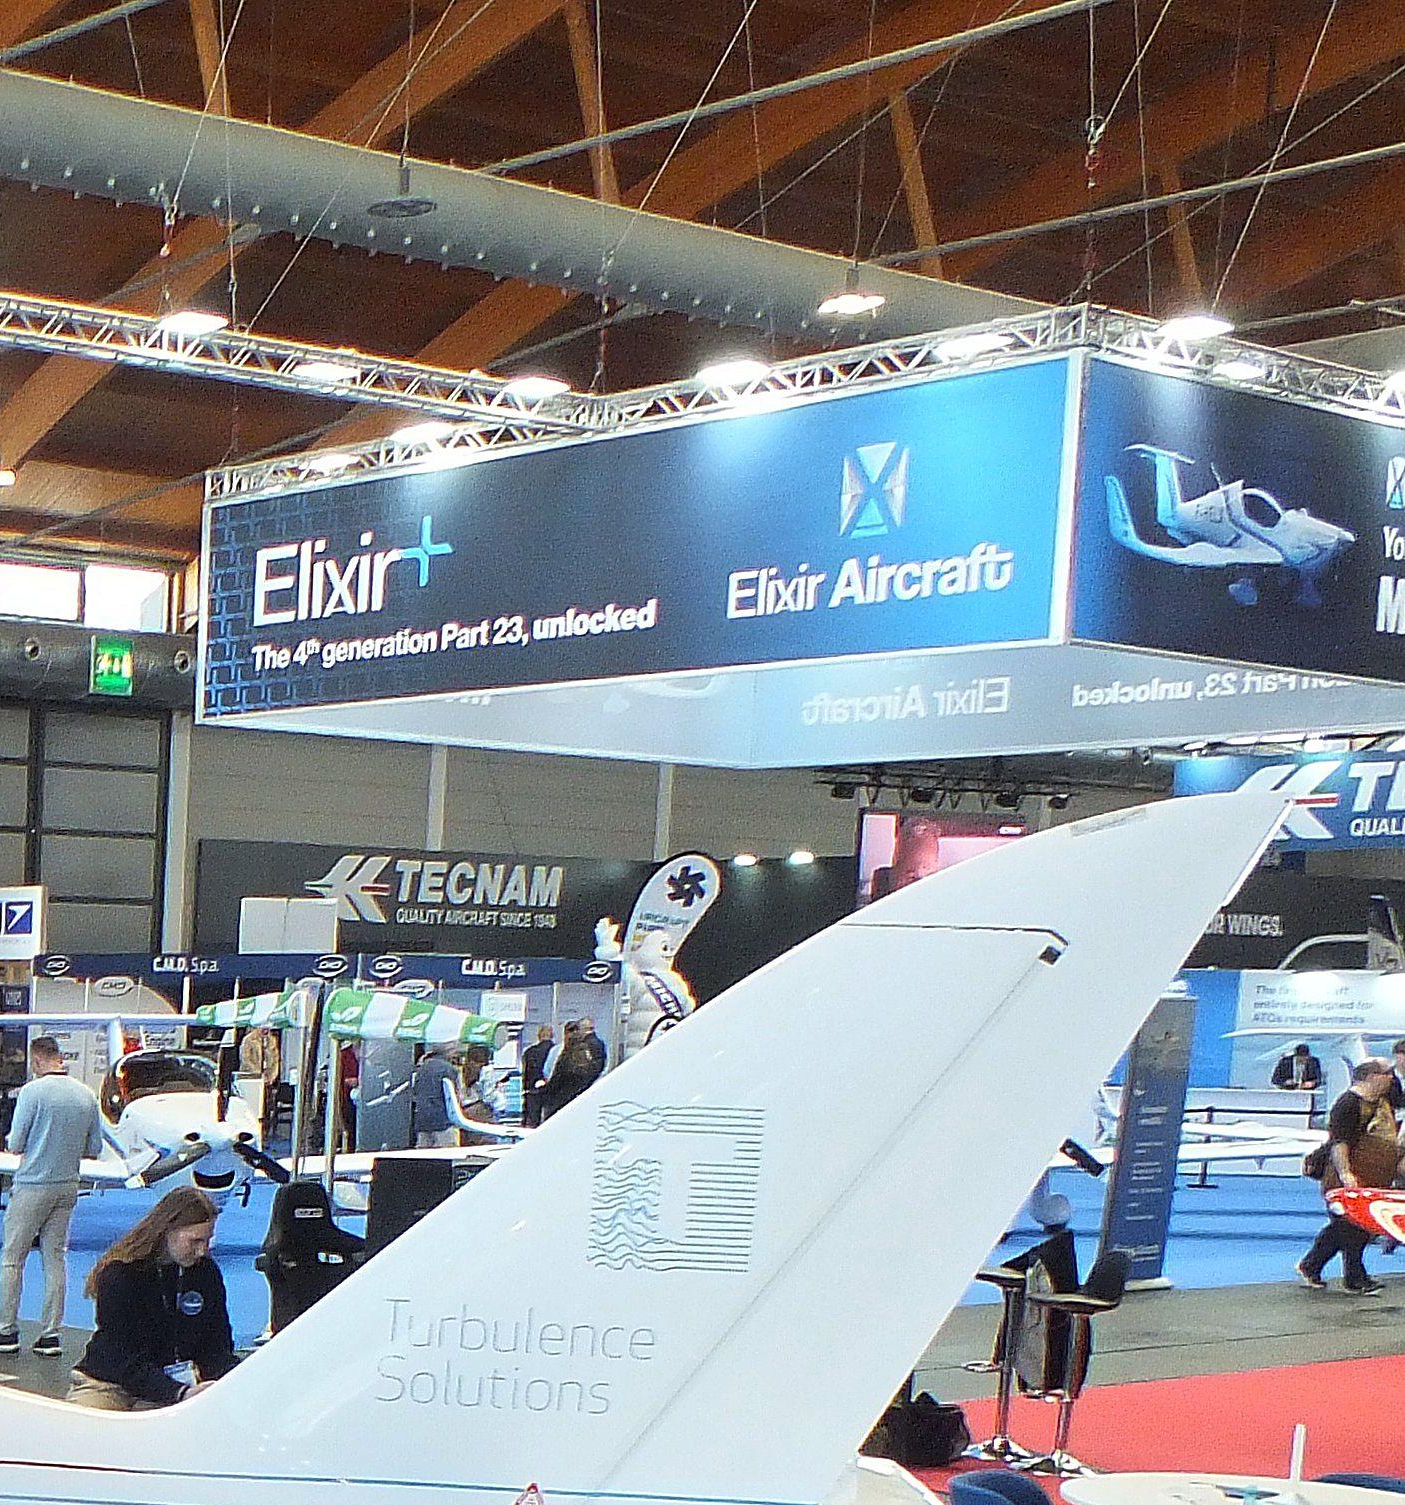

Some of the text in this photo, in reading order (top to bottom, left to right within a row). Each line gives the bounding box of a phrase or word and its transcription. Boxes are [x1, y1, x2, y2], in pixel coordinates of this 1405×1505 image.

[726, 543, 1014, 620] Elixir Aircraft
[252, 644, 290, 672] The
[322, 629, 437, 669] generation
[440, 618, 490, 651] Part
[492, 616, 528, 647] 23,
[532, 598, 658, 638] unlocked
[395, 860, 564, 908] TECNAM
[396, 908, 443, 925] QUALITY
[445, 909, 500, 926] AIRCRAFT
[384, 1298, 656, 1361] Turbulence
[374, 1355, 612, 1415] Solutions
